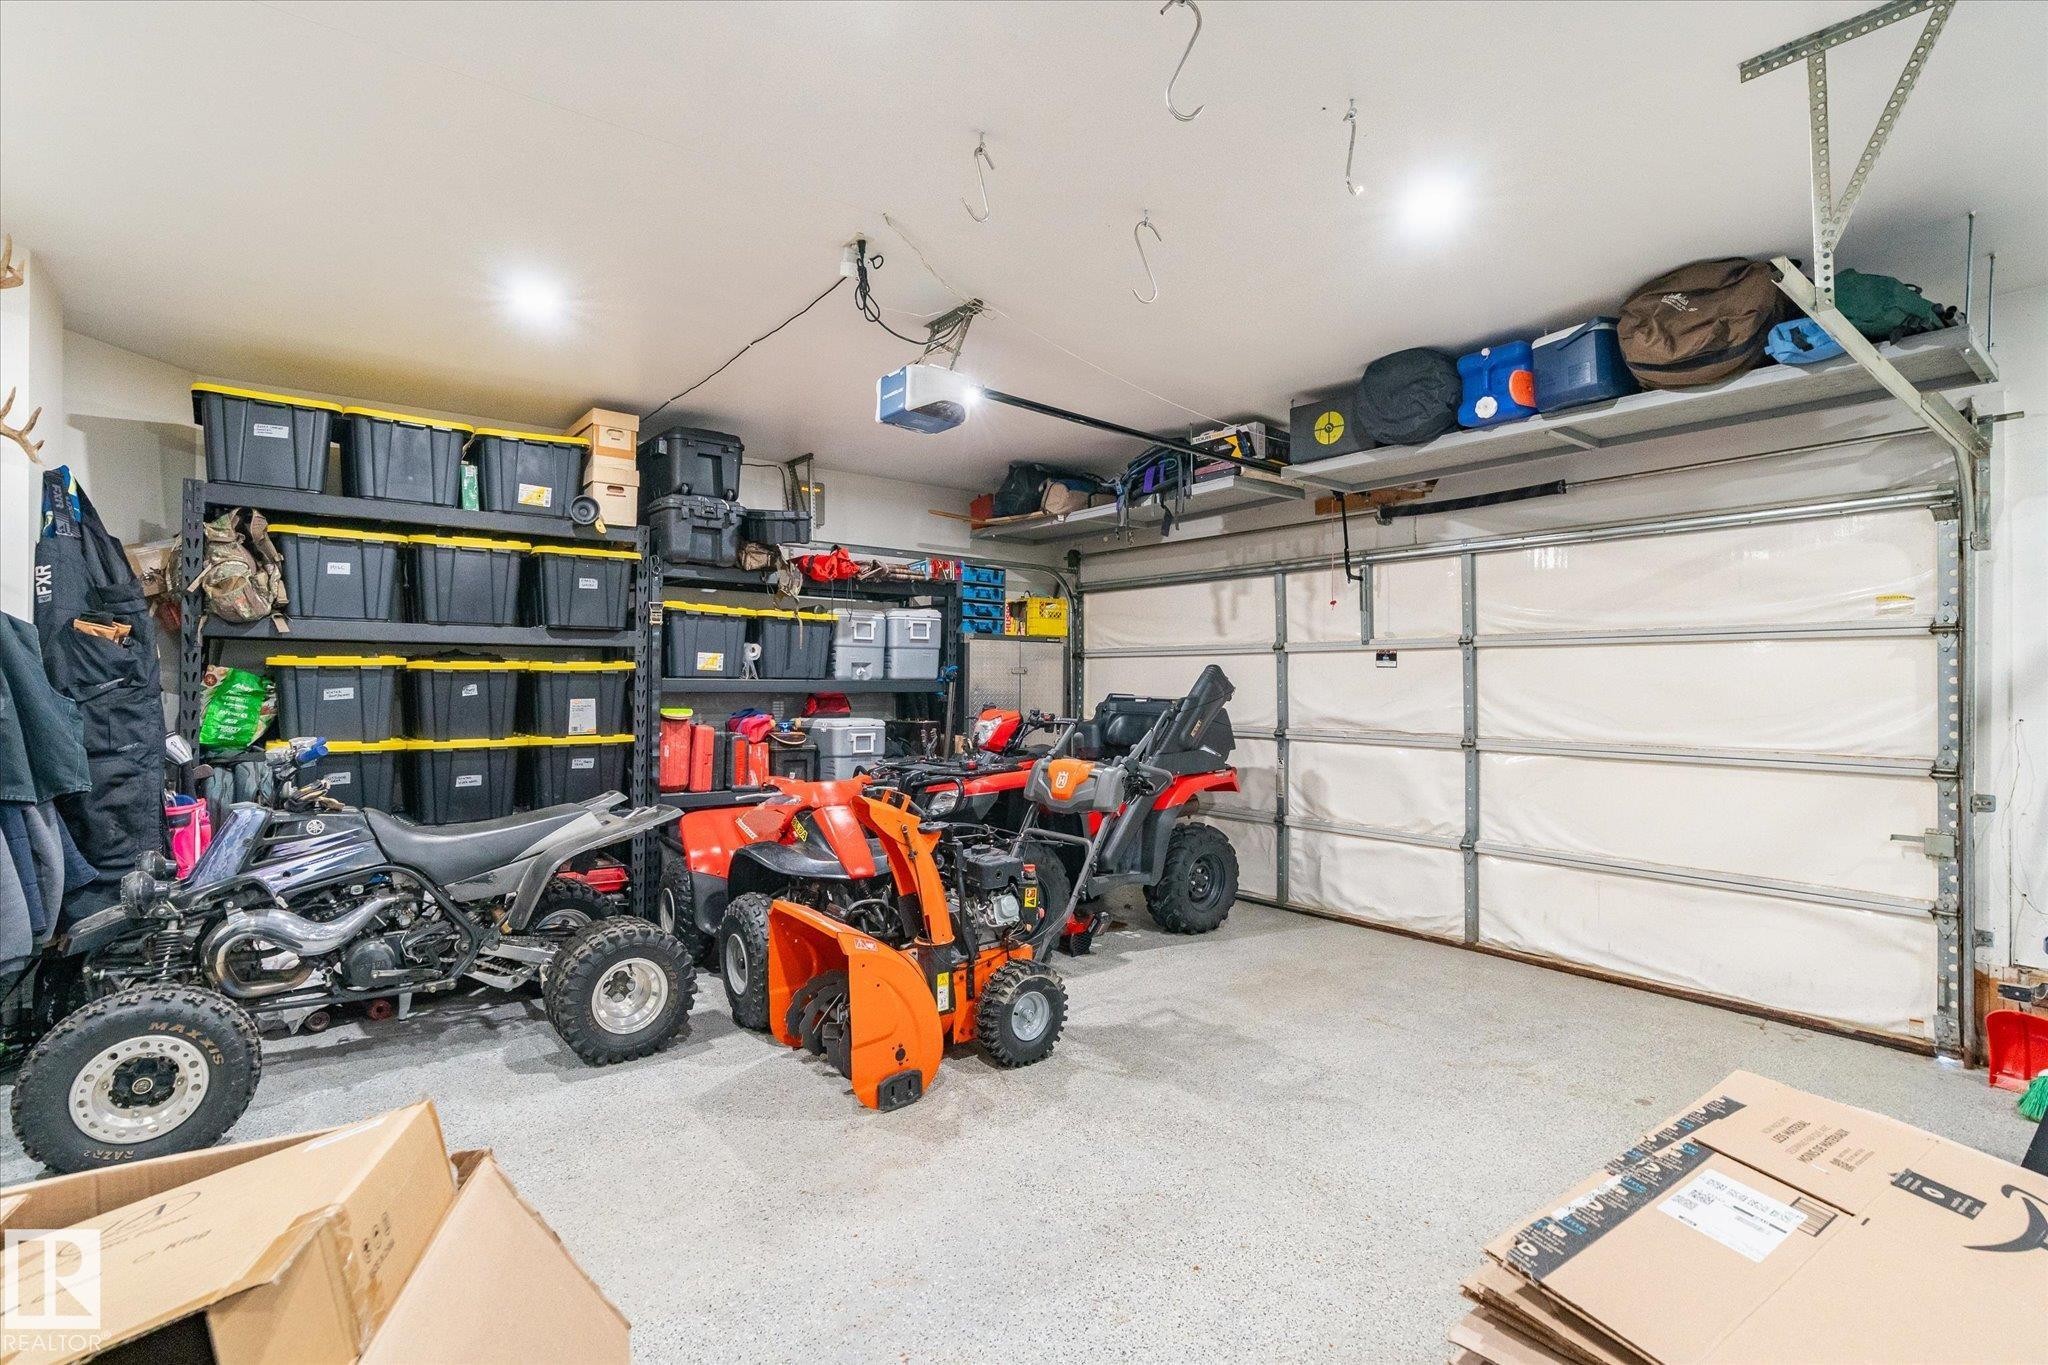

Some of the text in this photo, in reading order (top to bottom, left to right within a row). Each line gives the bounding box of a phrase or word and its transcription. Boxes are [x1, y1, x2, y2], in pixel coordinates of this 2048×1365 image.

[35, 564, 52, 597] FXR
[148, 1022, 224, 1065] MAXXIS
[92, 1149, 135, 1160] RAZR
